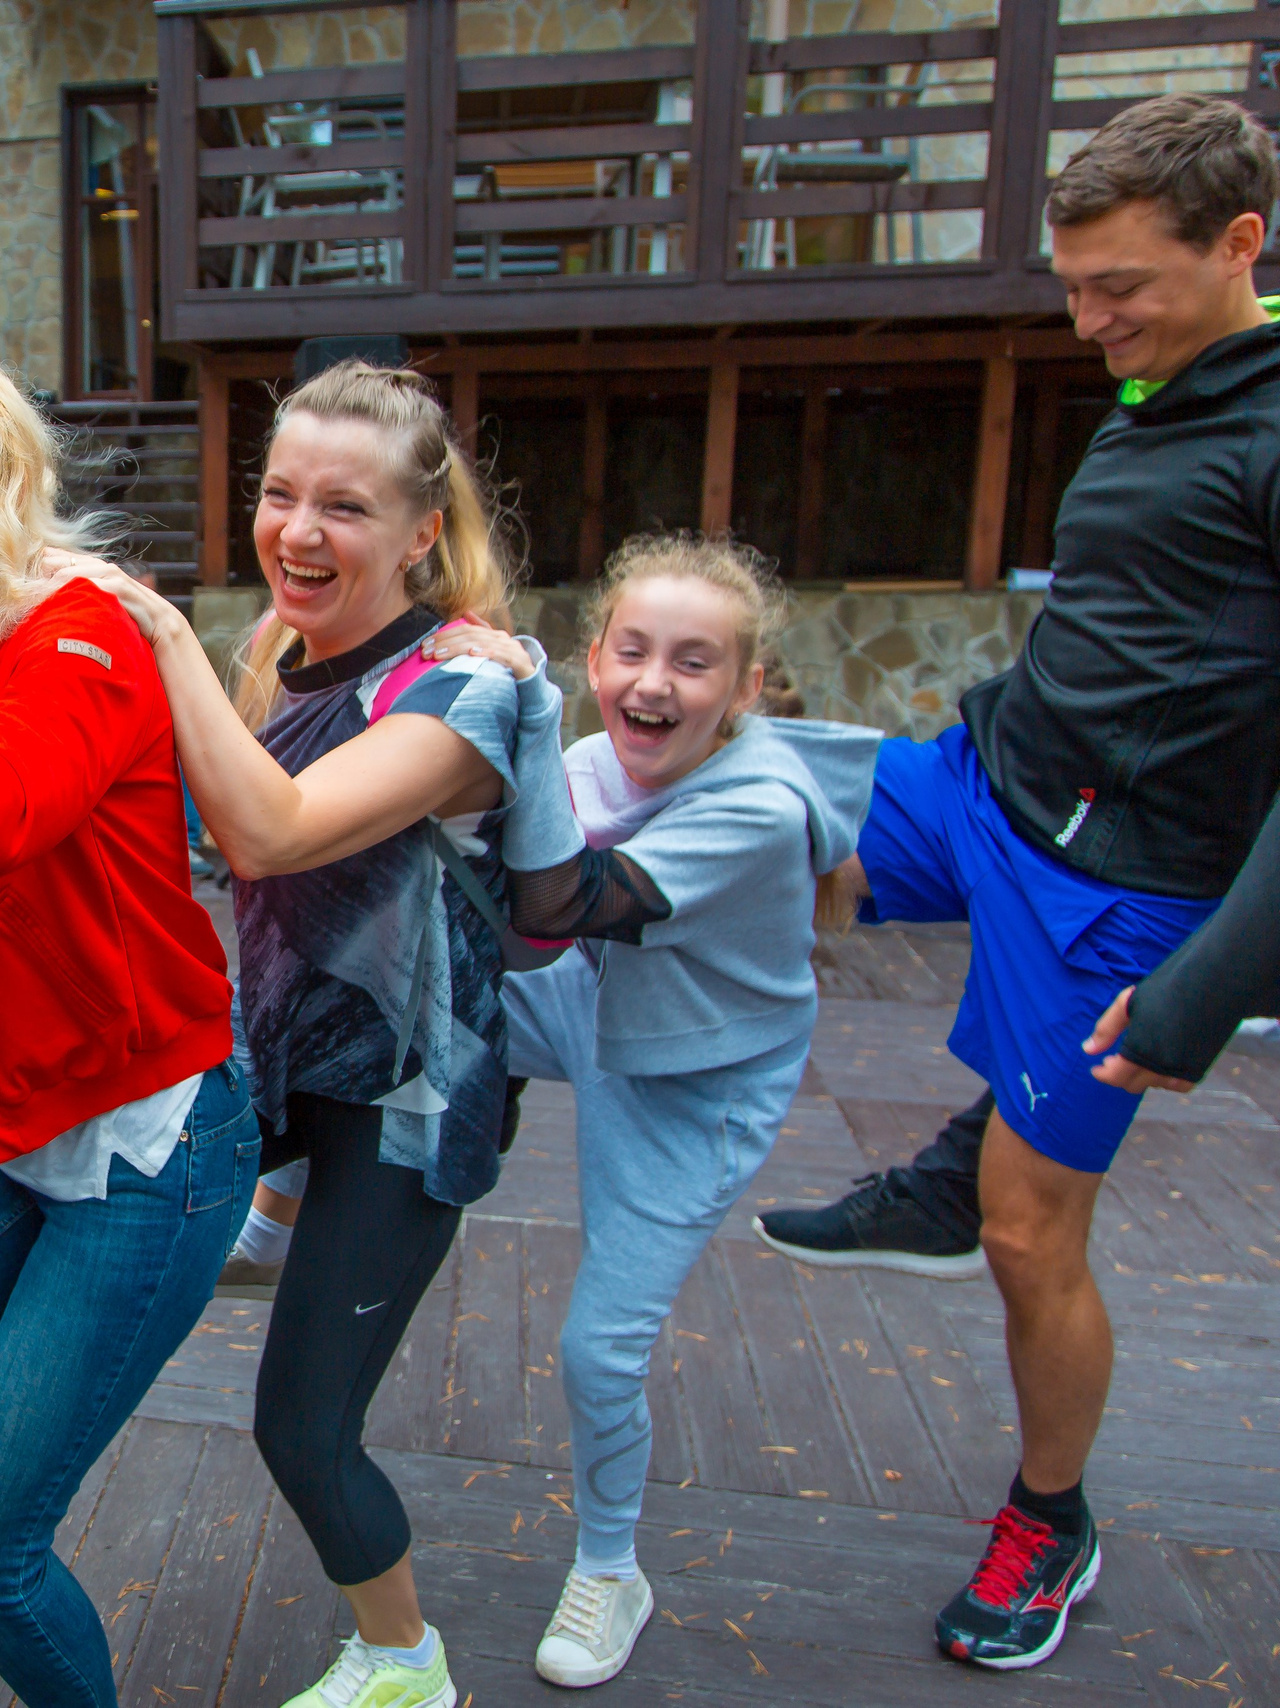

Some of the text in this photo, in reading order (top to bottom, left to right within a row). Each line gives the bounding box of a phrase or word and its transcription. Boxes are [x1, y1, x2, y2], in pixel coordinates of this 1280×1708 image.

[61, 641, 111, 665] CITY STAR
[1054, 799, 1091, 848] Reebok
